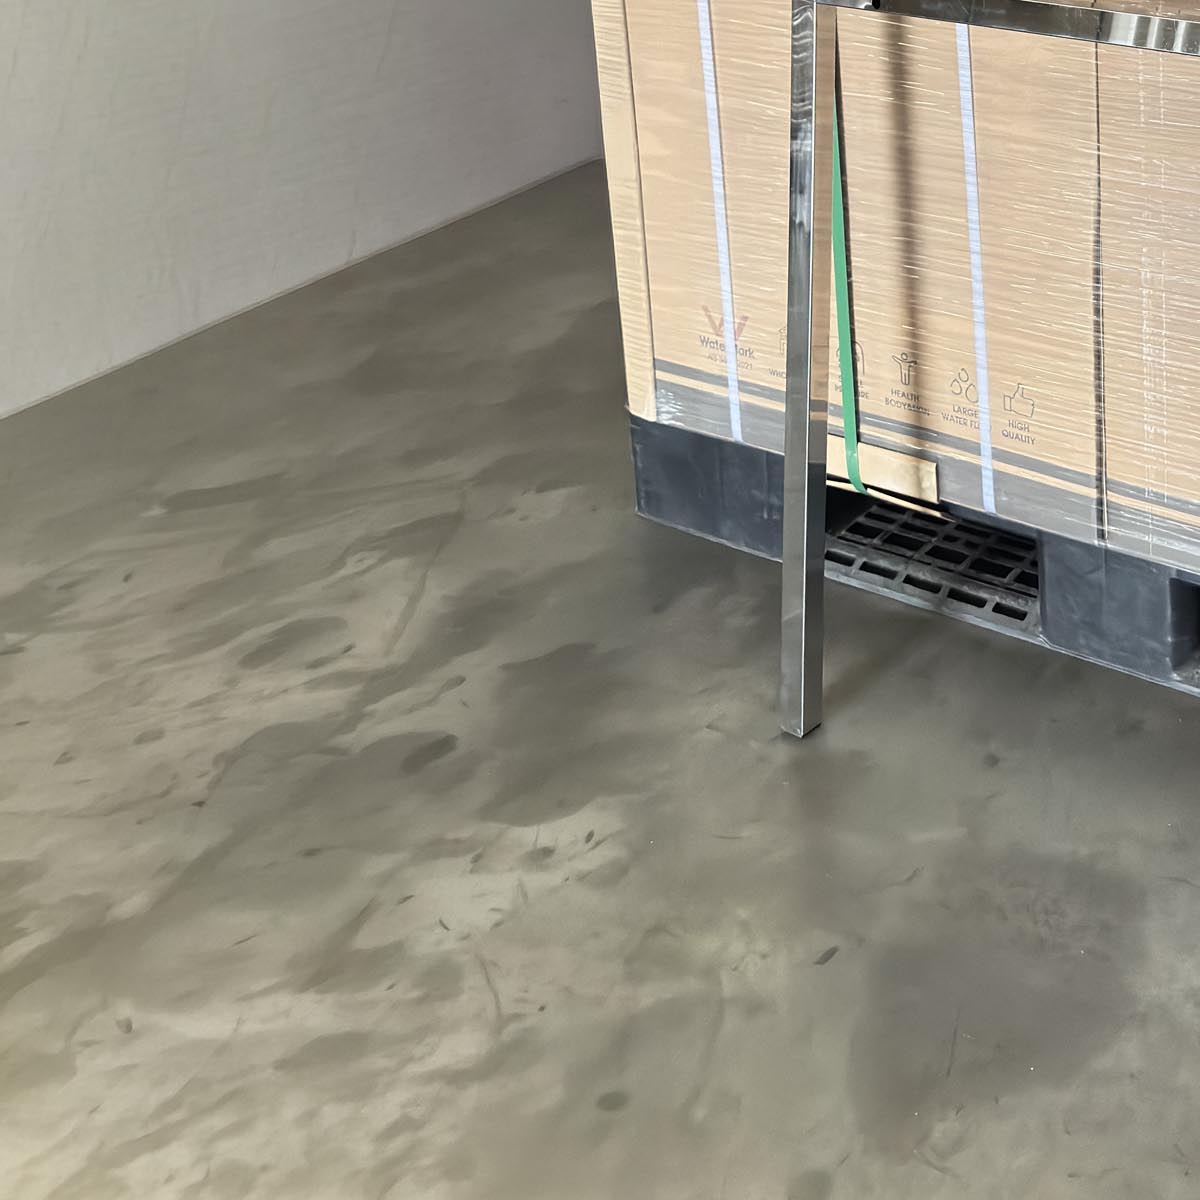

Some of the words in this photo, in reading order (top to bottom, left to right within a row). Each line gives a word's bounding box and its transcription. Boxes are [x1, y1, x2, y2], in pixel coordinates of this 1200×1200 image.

[699, 335, 755, 360] Wateark
[890, 388, 920, 402] HEALTH
[942, 412, 968, 426] WATER
[1008, 419, 1030, 433] HIGH
[1002, 428, 1037, 445] QUALITY
